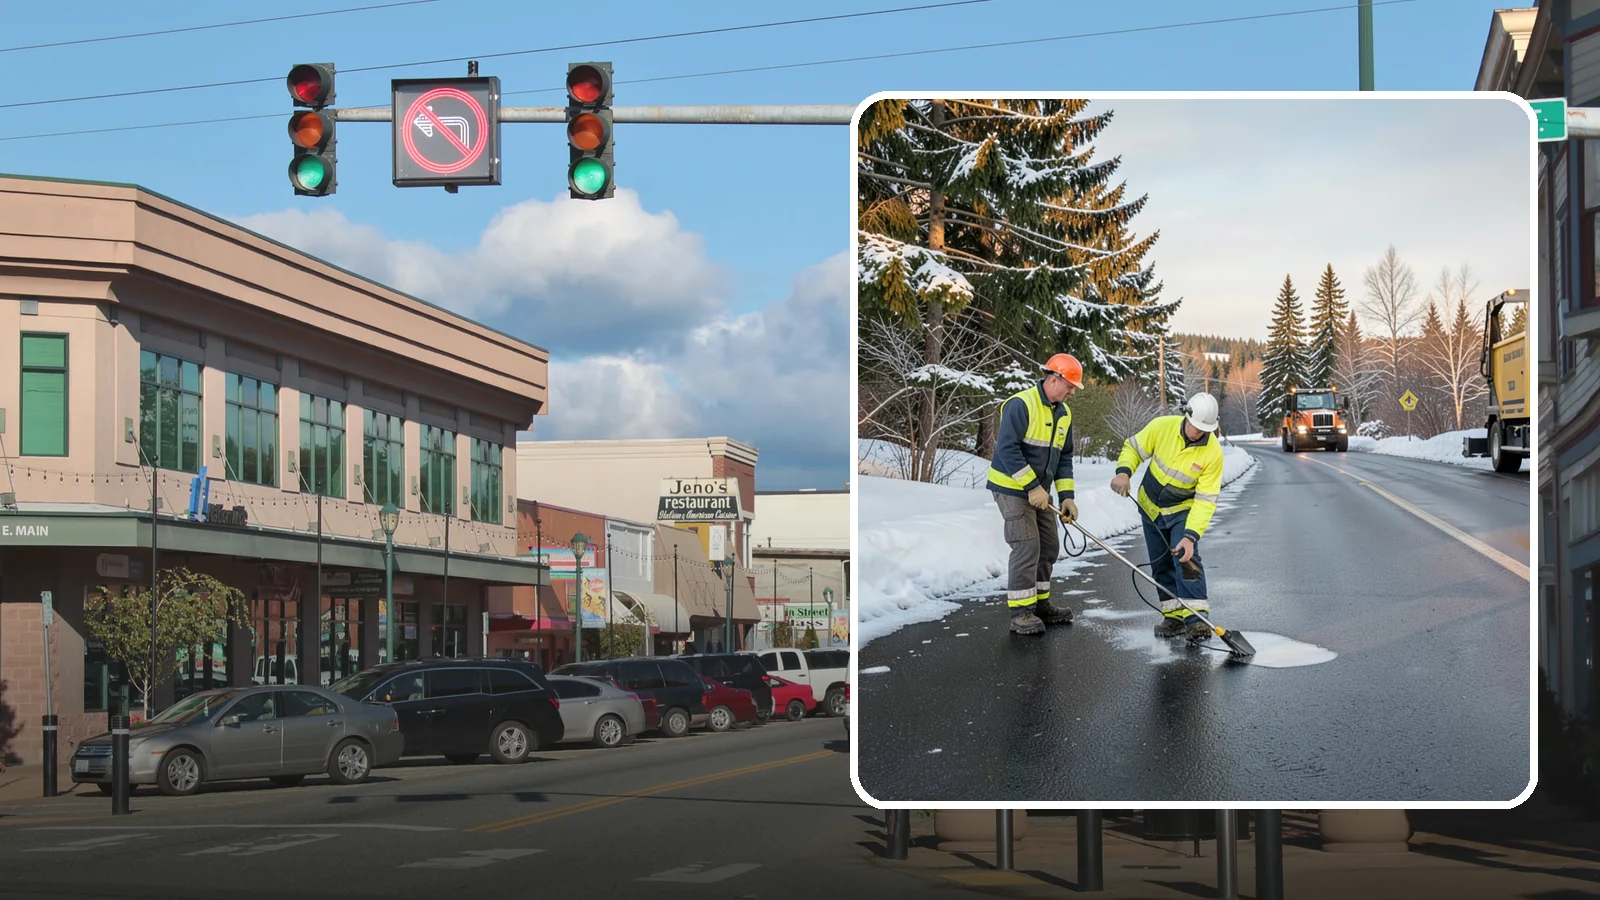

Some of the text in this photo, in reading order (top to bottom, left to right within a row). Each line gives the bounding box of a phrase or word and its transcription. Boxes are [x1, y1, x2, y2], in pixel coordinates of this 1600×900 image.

[669, 480, 728, 494] Jeno's
[664, 496, 731, 509] restaurant
[658, 510, 682, 519] Italian
[686, 510, 715, 519] American
[715, 509, 737, 519] Cuisine
[2, 525, 49, 536] E. MAIN
[797, 607, 828, 617] Street
